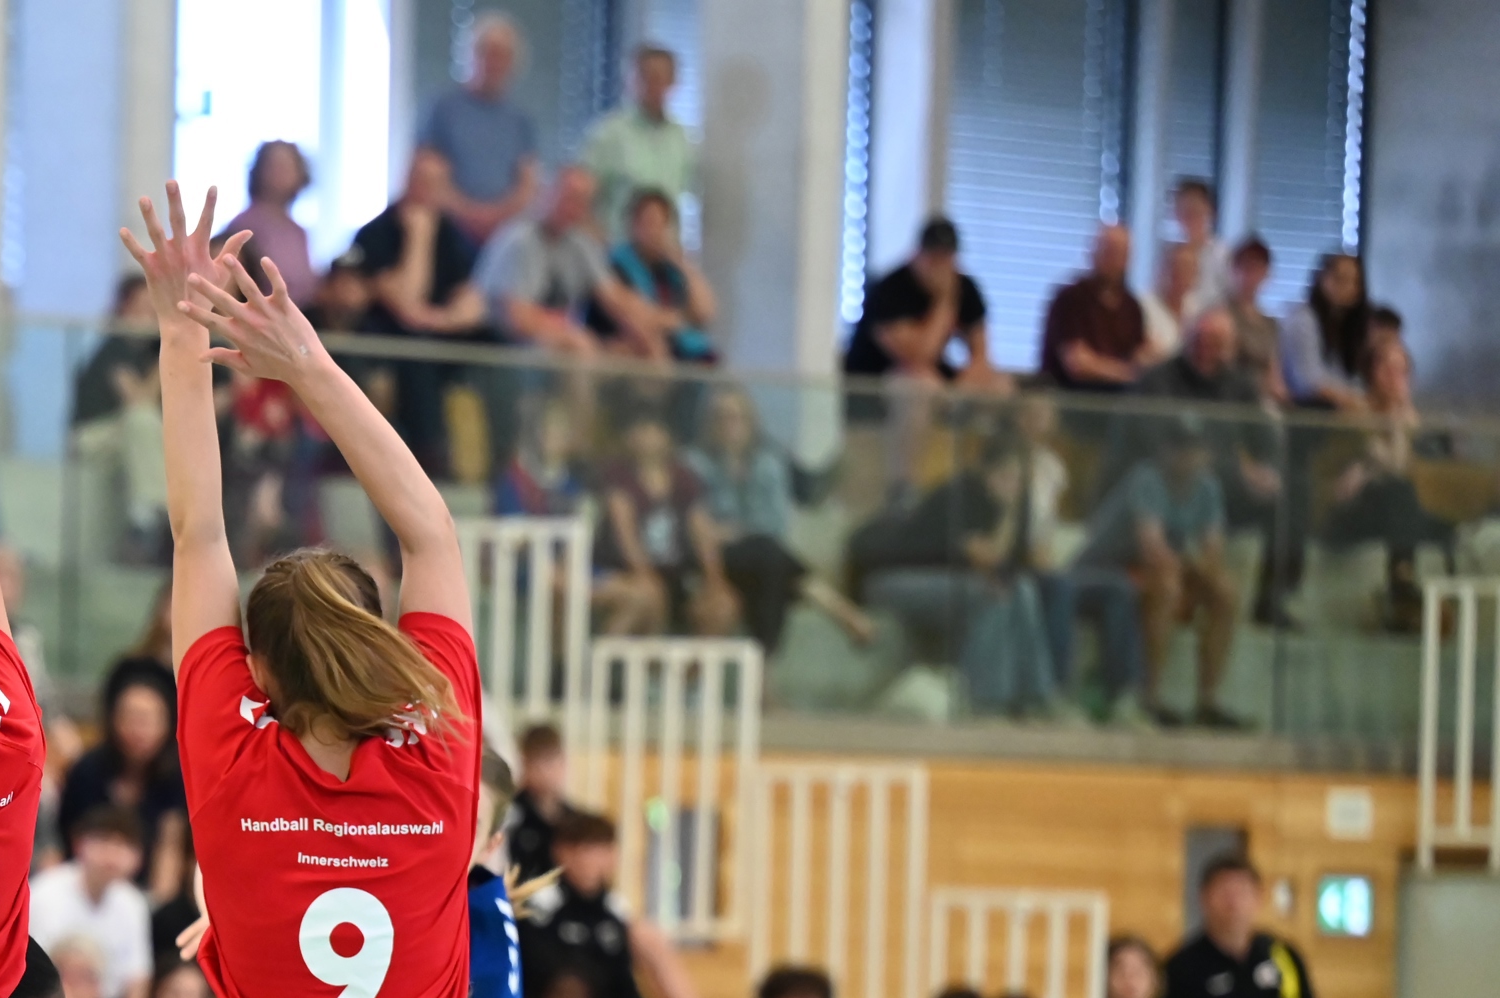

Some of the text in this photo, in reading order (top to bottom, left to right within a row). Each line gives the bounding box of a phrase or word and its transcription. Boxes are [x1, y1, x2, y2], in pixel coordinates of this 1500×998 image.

[241, 817, 444, 837] Handball Regionalauswahl
[297, 852, 389, 868] Innerschweiz
